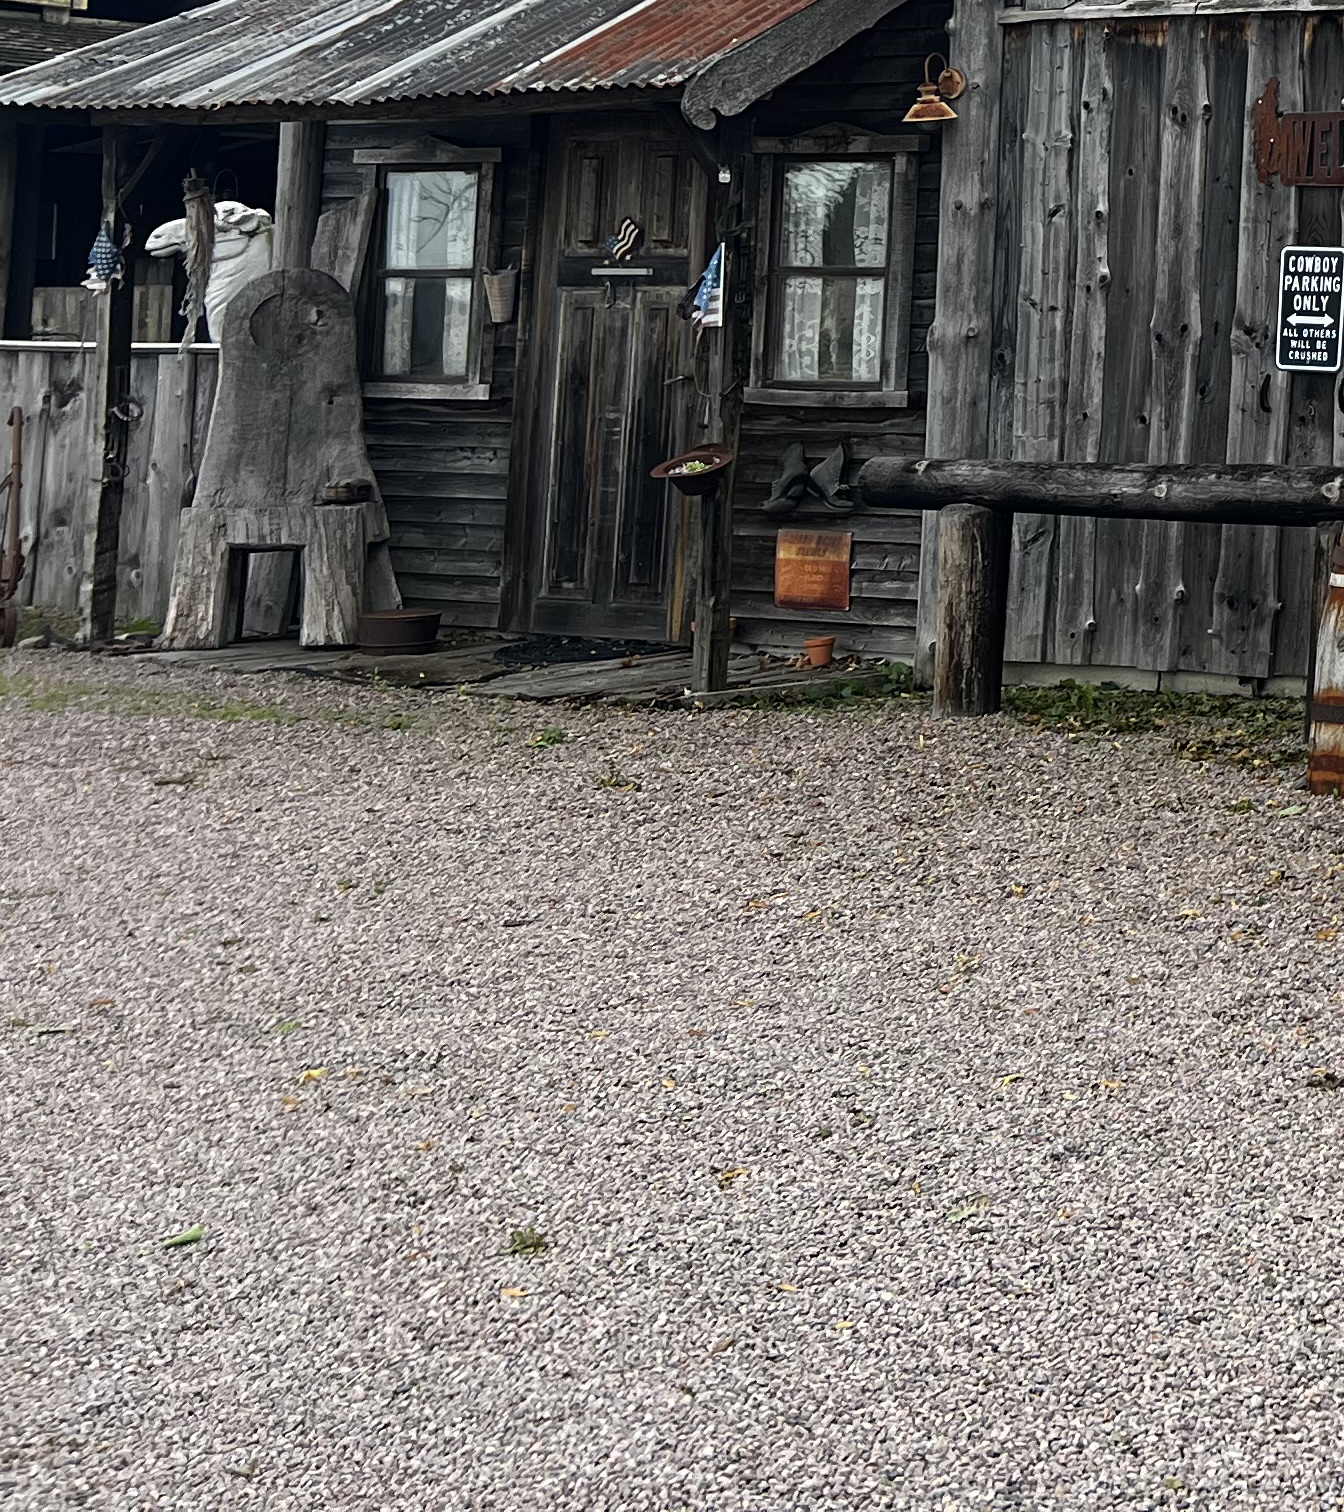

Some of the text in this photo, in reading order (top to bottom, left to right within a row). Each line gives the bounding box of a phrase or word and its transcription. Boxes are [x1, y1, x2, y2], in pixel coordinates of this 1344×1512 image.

[1288, 255, 1339, 273] COWBOY
[1284, 275, 1341, 293] PARKING
[1293, 294, 1329, 312] ONLY
[1282, 328, 1337, 339] ALL OTHERS
[1290, 339, 1327, 350] WILL BE
[1288, 350, 1329, 362] CRUSHED
